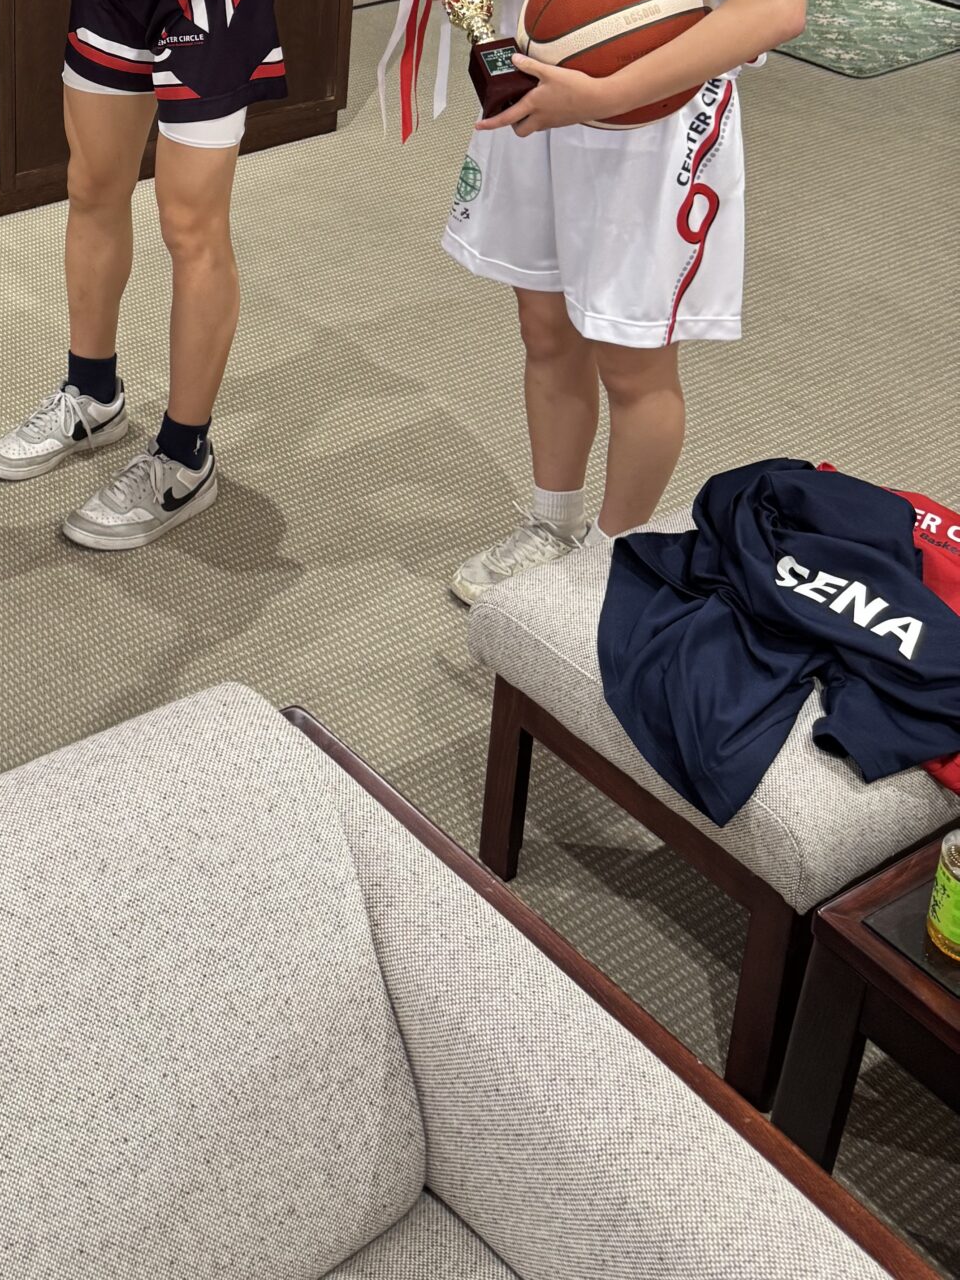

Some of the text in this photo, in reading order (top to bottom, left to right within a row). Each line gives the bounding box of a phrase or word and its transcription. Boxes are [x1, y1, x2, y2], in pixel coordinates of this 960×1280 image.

[179, 33, 204, 42] CIRCLE
[677, 111, 712, 186] CENTER
[775, 555, 923, 660] SENA
